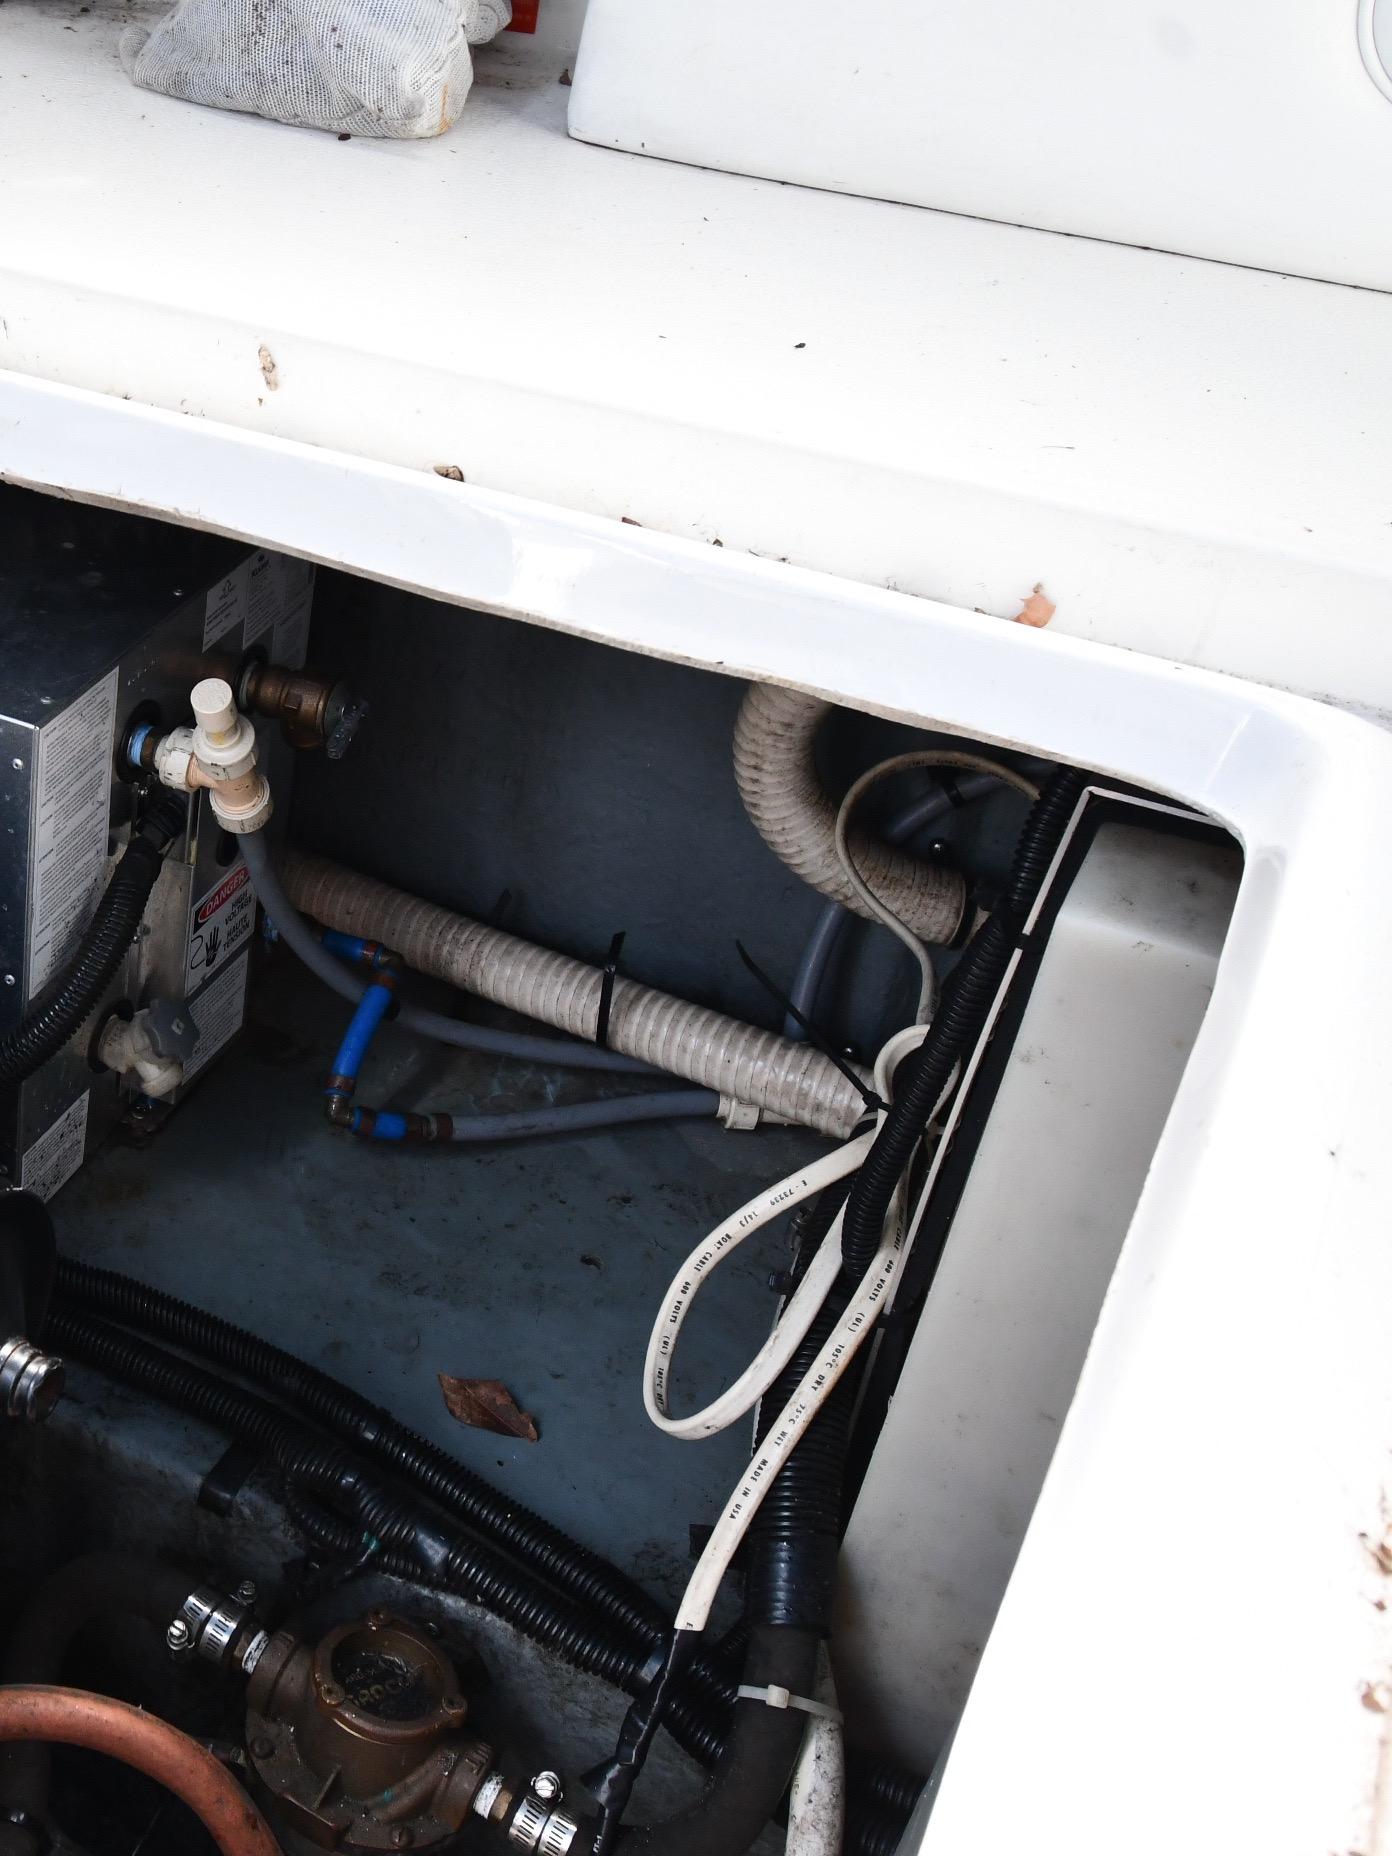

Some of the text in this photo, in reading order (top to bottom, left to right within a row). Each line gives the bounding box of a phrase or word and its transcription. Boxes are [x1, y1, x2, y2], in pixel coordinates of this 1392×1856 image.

[207, 869, 246, 915] DANGER
[231, 889, 248, 912] HIGH
[225, 894, 252, 926] VOLTAGE
[223, 920, 250, 951] TENSION
[227, 913, 248, 938] HAUTE
[715, 1233, 733, 1250] BOAT
[694, 1251, 713, 1272] CABLE
[884, 1259, 894, 1274] 600
[681, 1281, 691, 1295] 600
[868, 1278, 886, 1302] VOLTS
[669, 1300, 683, 1324] VOLTS
[810, 1374, 826, 1392] DRY
[774, 1430, 789, 1447] WET
[750, 1458, 769, 1482] MADE
[741, 1486, 752, 1498] IN
[729, 1503, 743, 1520] USA
